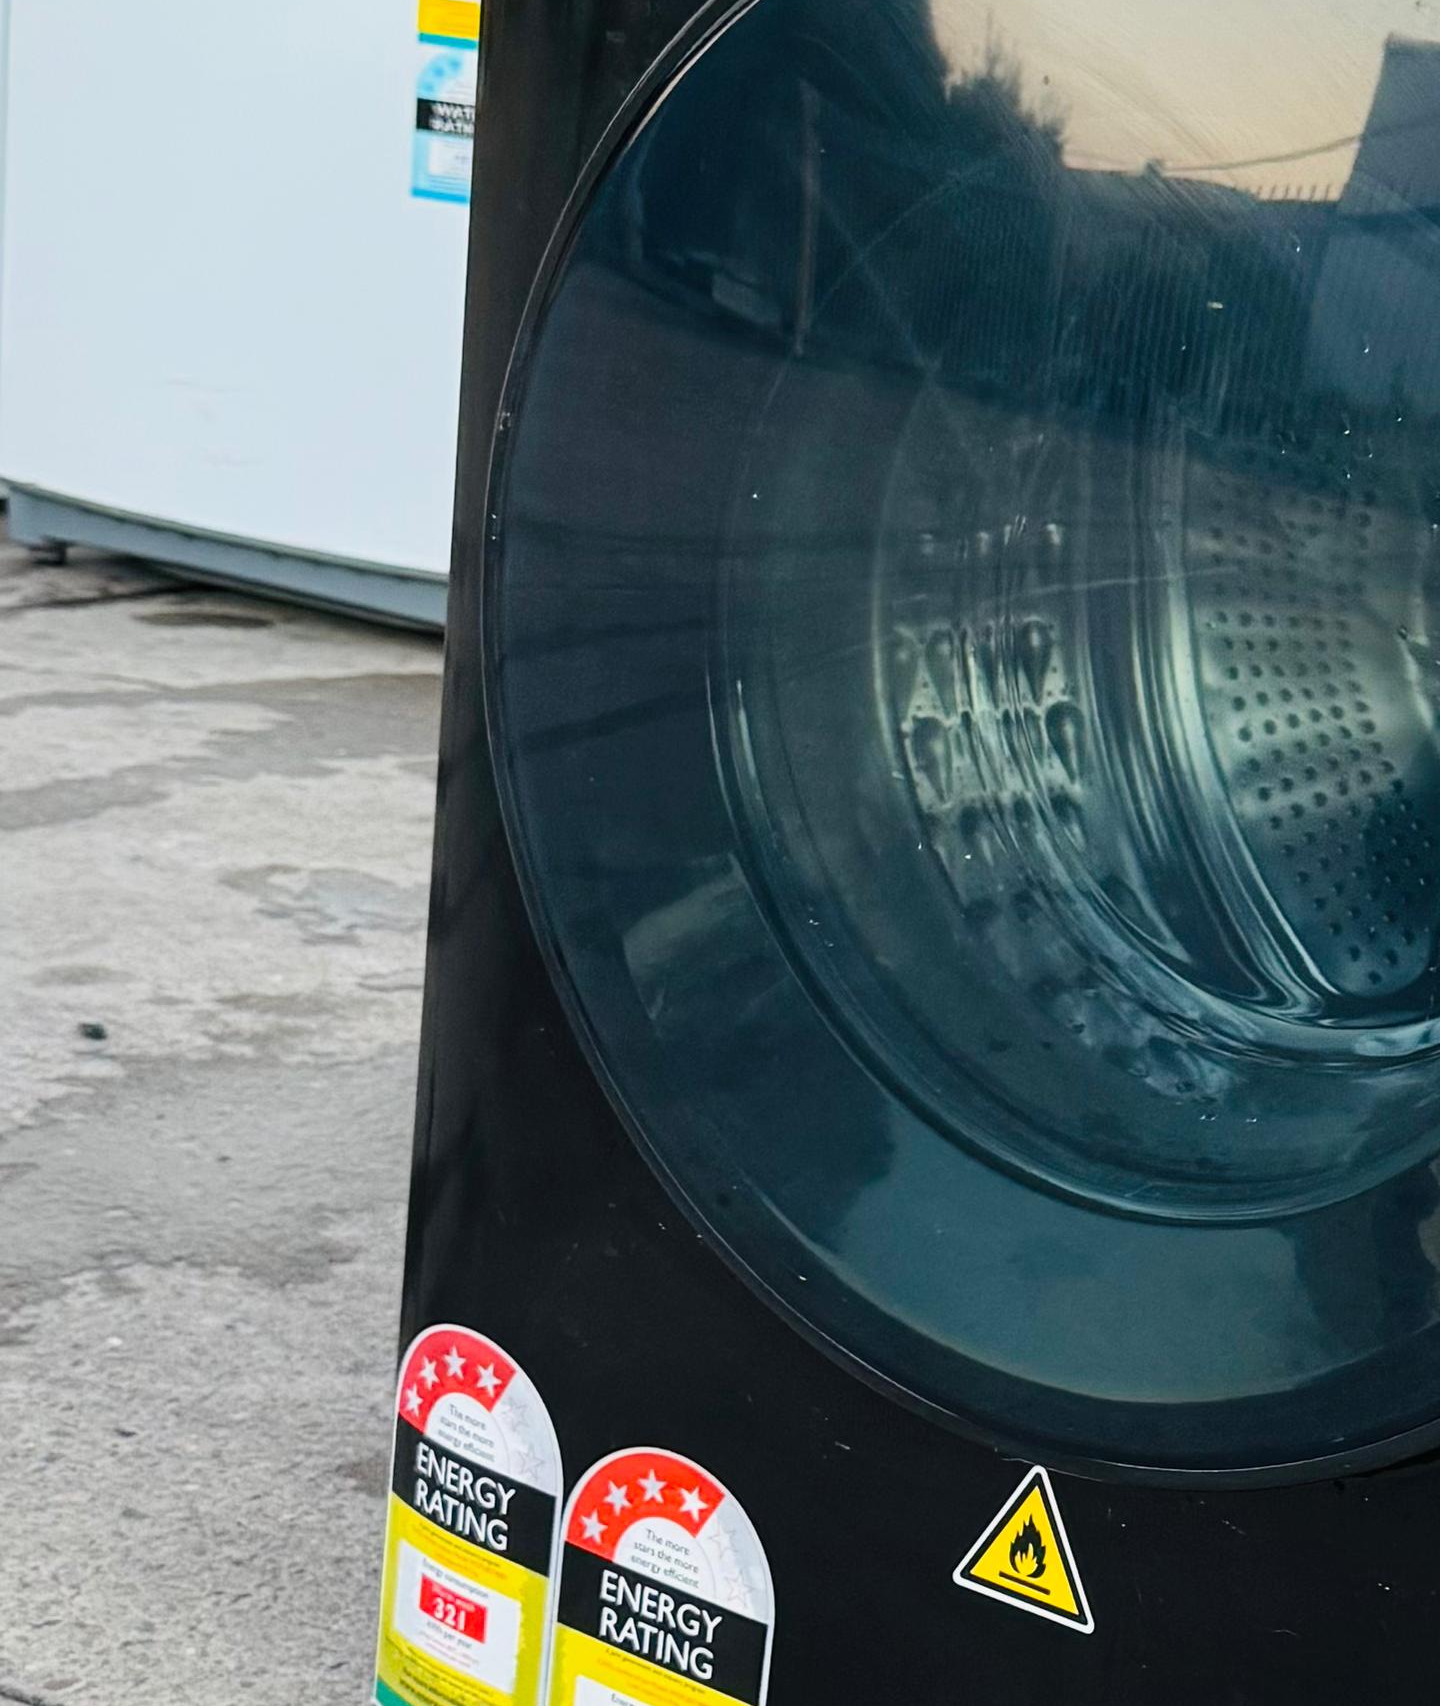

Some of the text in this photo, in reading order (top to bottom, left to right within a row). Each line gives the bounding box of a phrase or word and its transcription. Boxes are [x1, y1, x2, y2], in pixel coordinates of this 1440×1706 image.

[415, 1478, 508, 1551] RATING
[416, 1441, 516, 1515] ENERGY
[634, 1542, 699, 1574] stars the more
[646, 1529, 690, 1556] The more
[433, 1596, 466, 1632] 321
[600, 1569, 722, 1643] ENERGY
[600, 1606, 714, 1680] RATING
